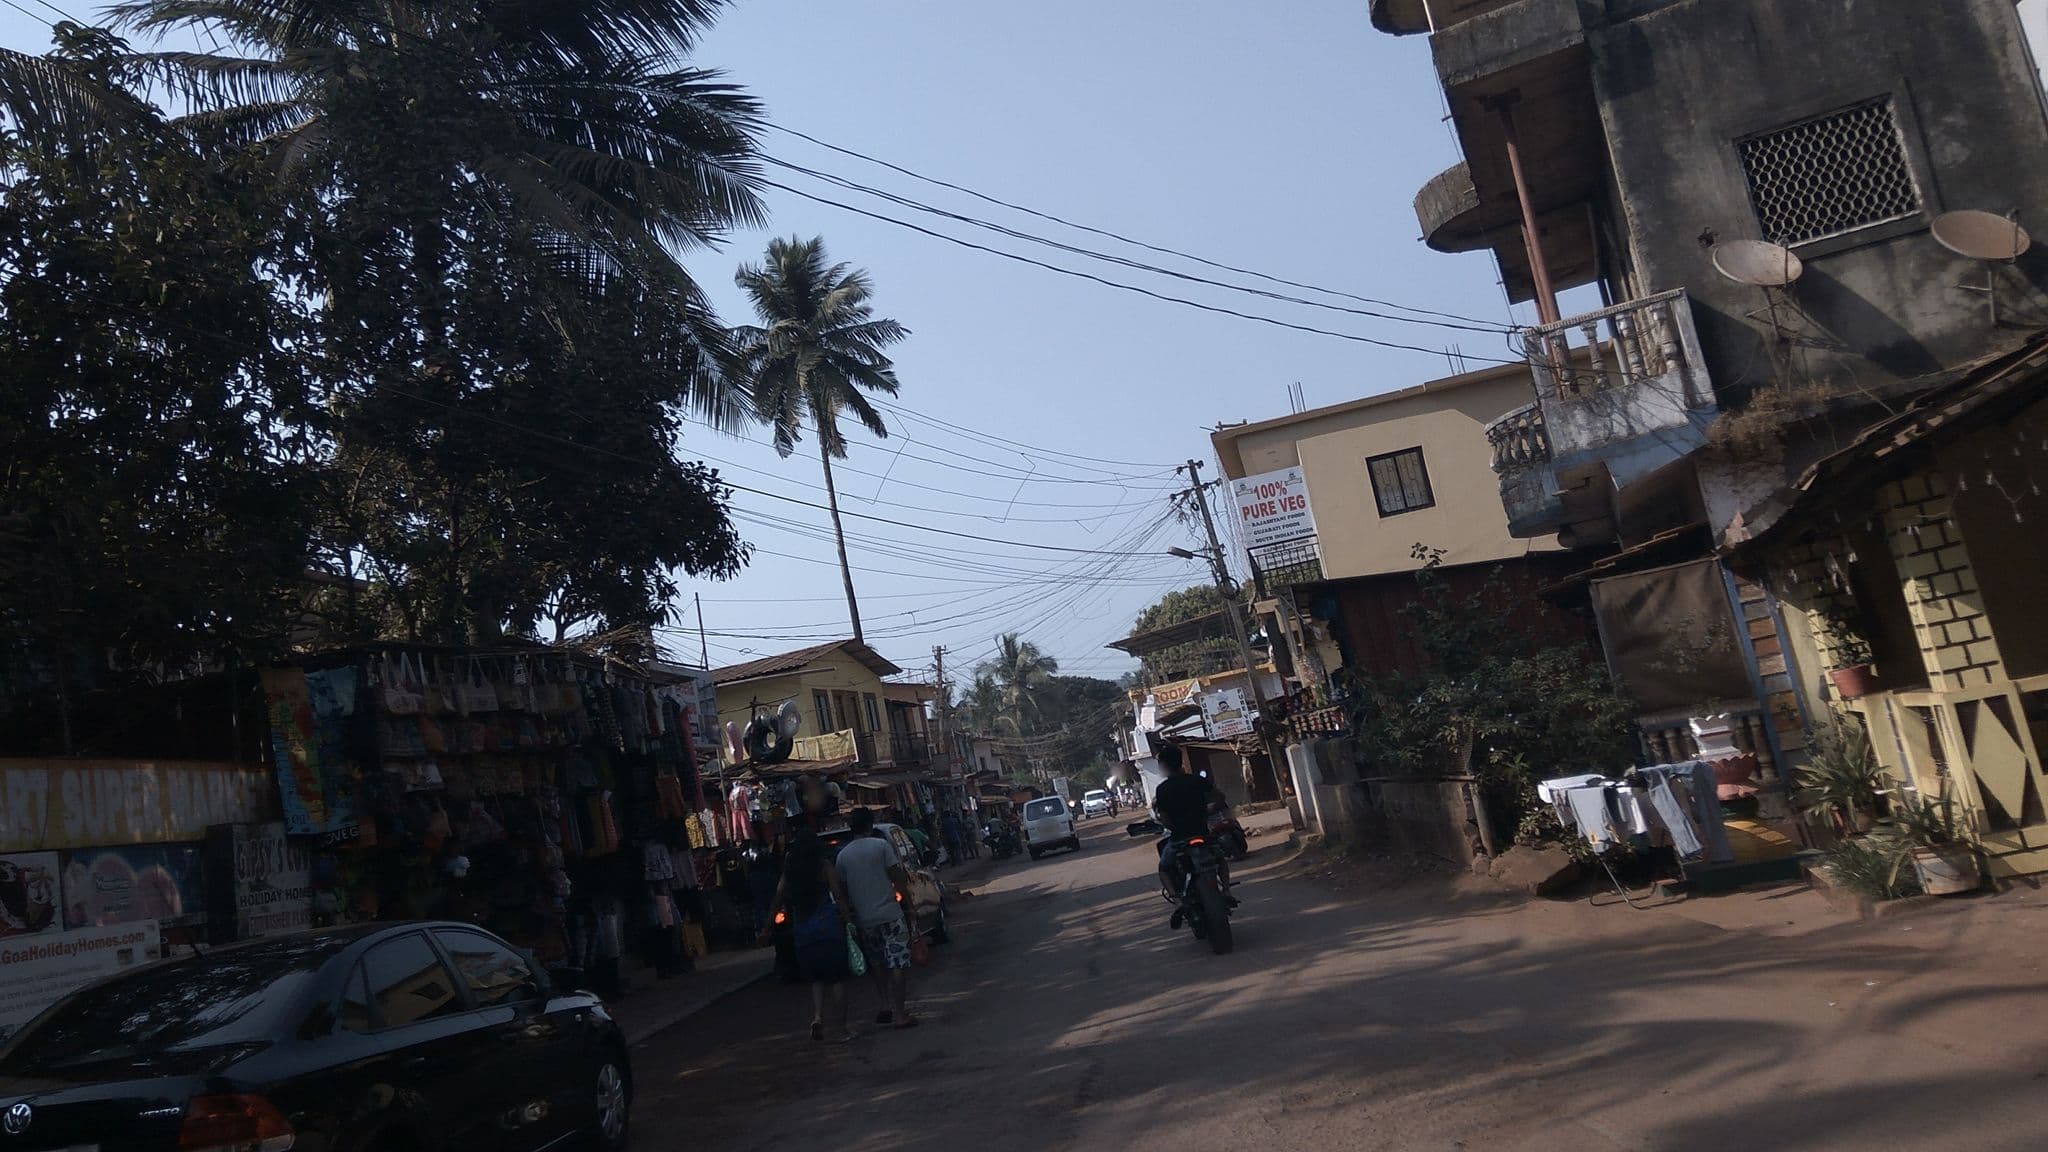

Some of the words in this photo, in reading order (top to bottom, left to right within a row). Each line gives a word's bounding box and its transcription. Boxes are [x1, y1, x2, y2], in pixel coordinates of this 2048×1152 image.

[1254, 480, 1287, 500] 100%
[1242, 505, 1277, 521] PURE
[1279, 494, 1306, 512] VEG
[1287, 512, 1305, 520] FOODS
[1254, 526, 1281, 535] GUJARATI
[1275, 531, 1294, 539] INDIAN
[1296, 527, 1313, 535] FOODS
[62, 765, 163, 838] SUPER
[239, 887, 282, 909] HOLIDAY
